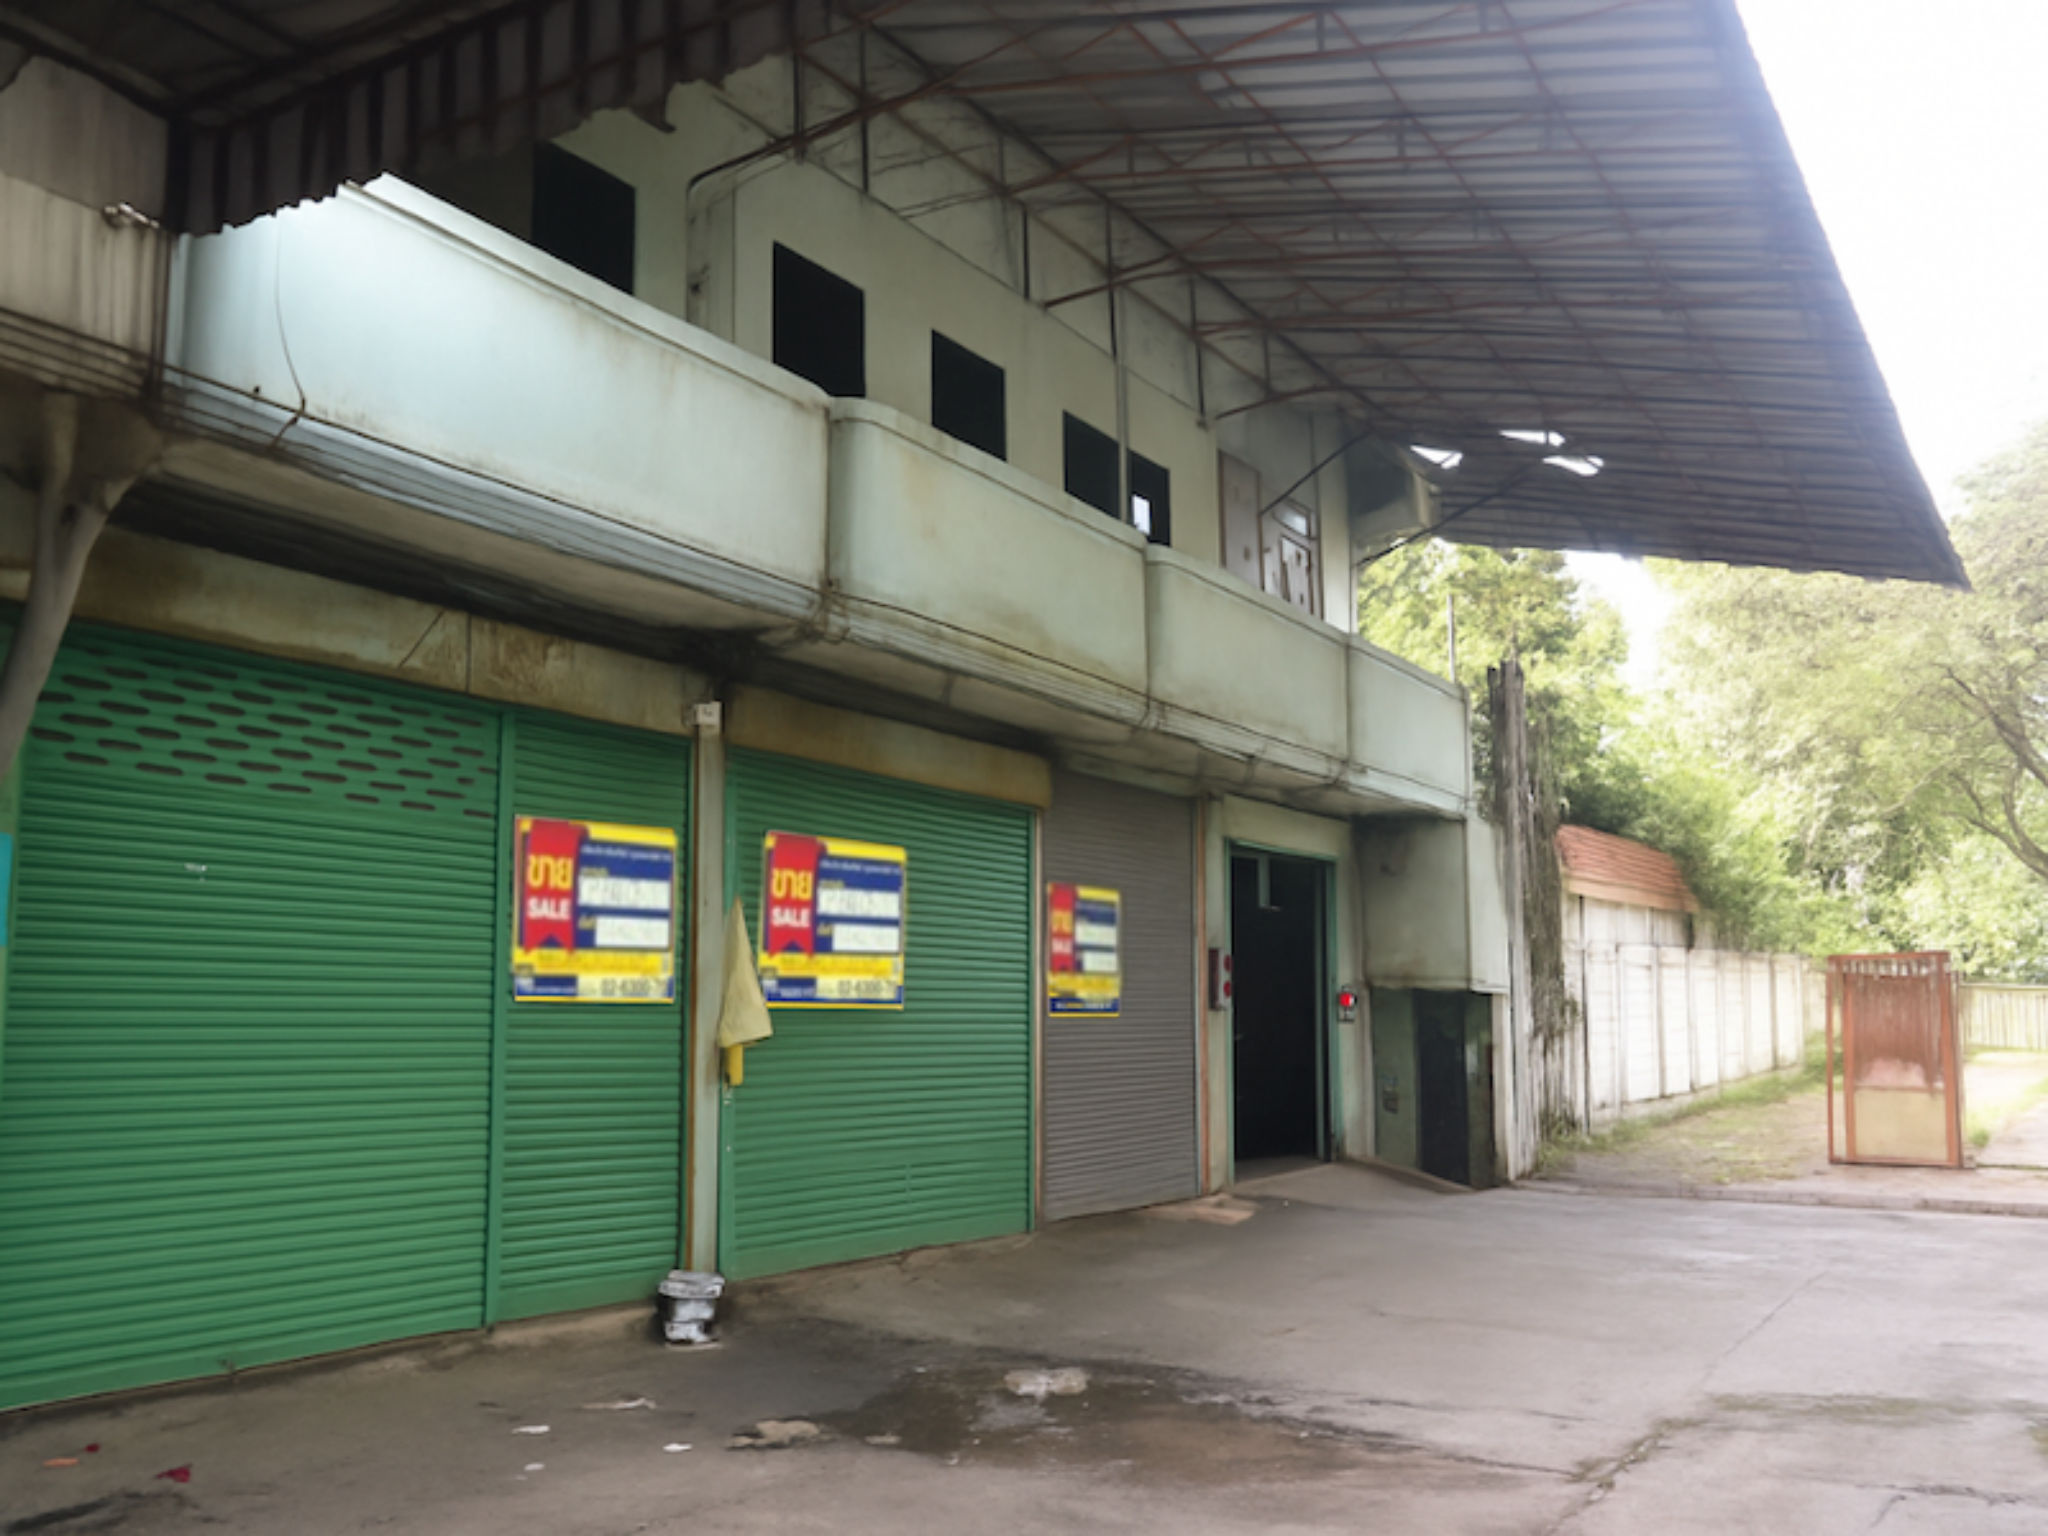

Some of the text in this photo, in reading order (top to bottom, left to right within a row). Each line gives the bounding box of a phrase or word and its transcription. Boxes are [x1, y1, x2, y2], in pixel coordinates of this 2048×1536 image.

[528, 855, 574, 890] ขาย
[528, 897, 571, 920] SALE
[771, 907, 811, 928] SALE
